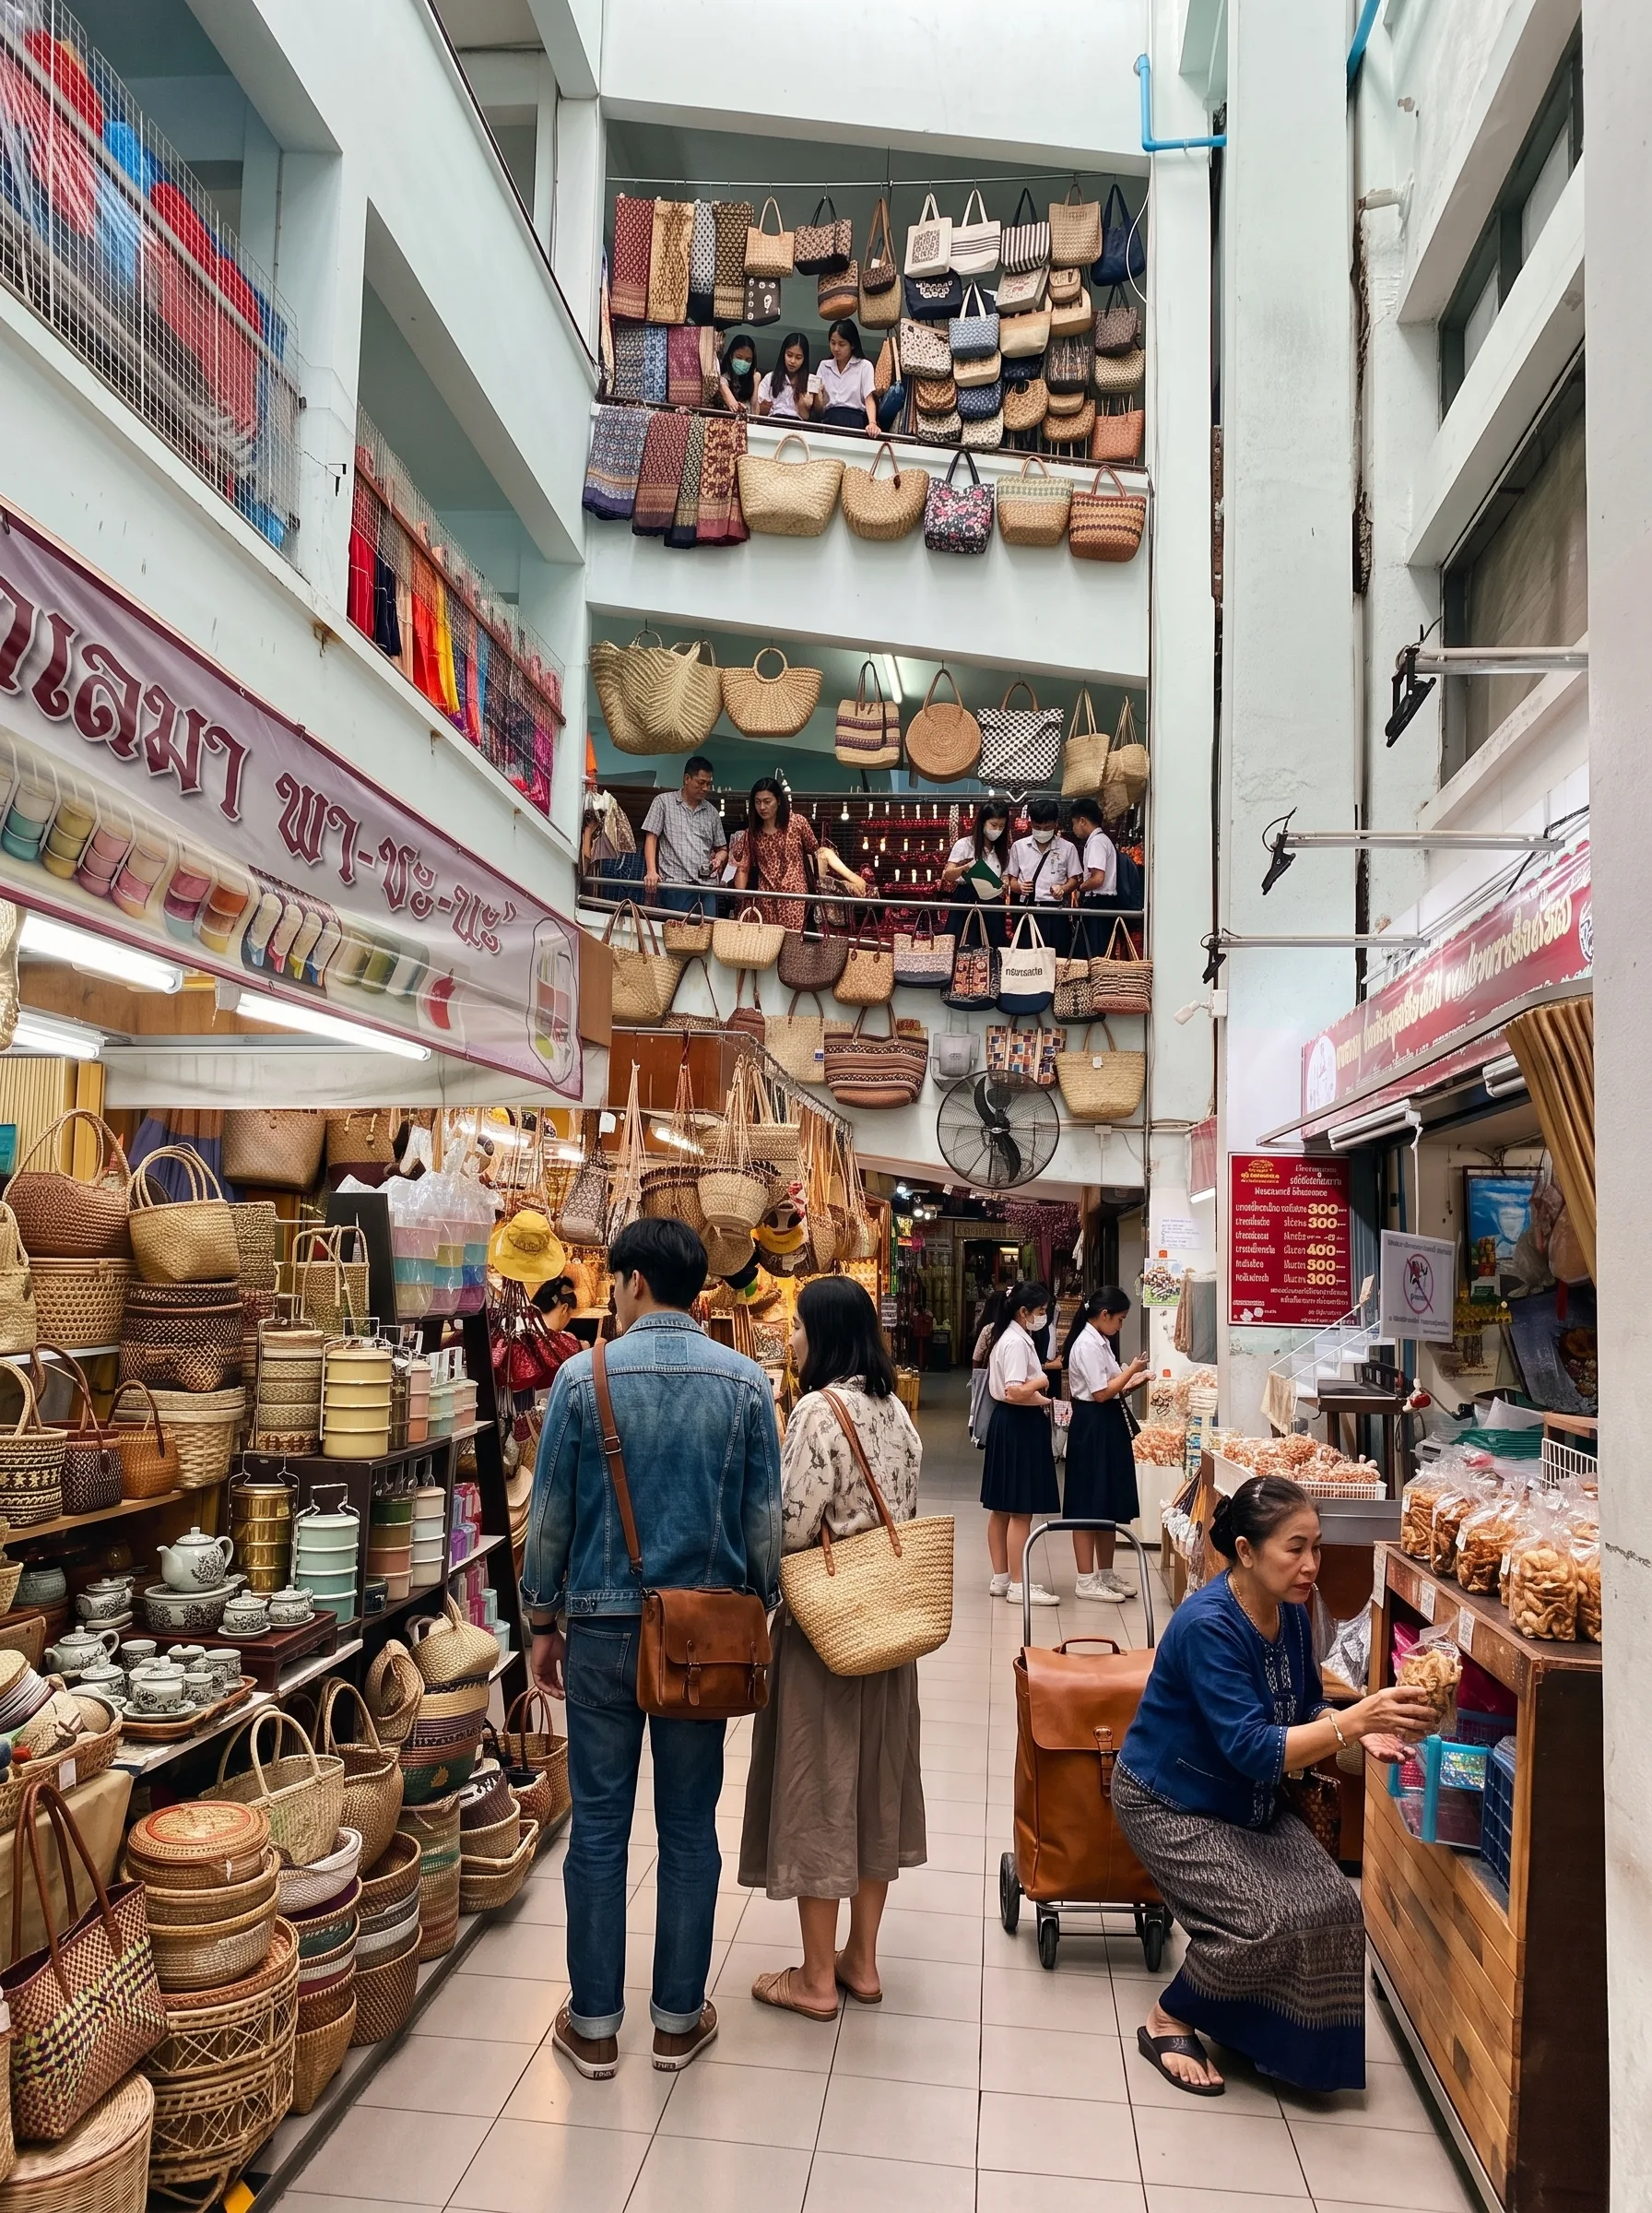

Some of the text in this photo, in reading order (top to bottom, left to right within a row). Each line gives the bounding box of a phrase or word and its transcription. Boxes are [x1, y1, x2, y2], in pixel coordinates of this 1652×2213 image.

[1308, 1203, 1338, 1214] 300
[1308, 1217, 1338, 1228] 300
[1306, 1243, 1336, 1256] 400
[1306, 1259, 1336, 1271] 500
[1306, 1272, 1336, 1285] 300
